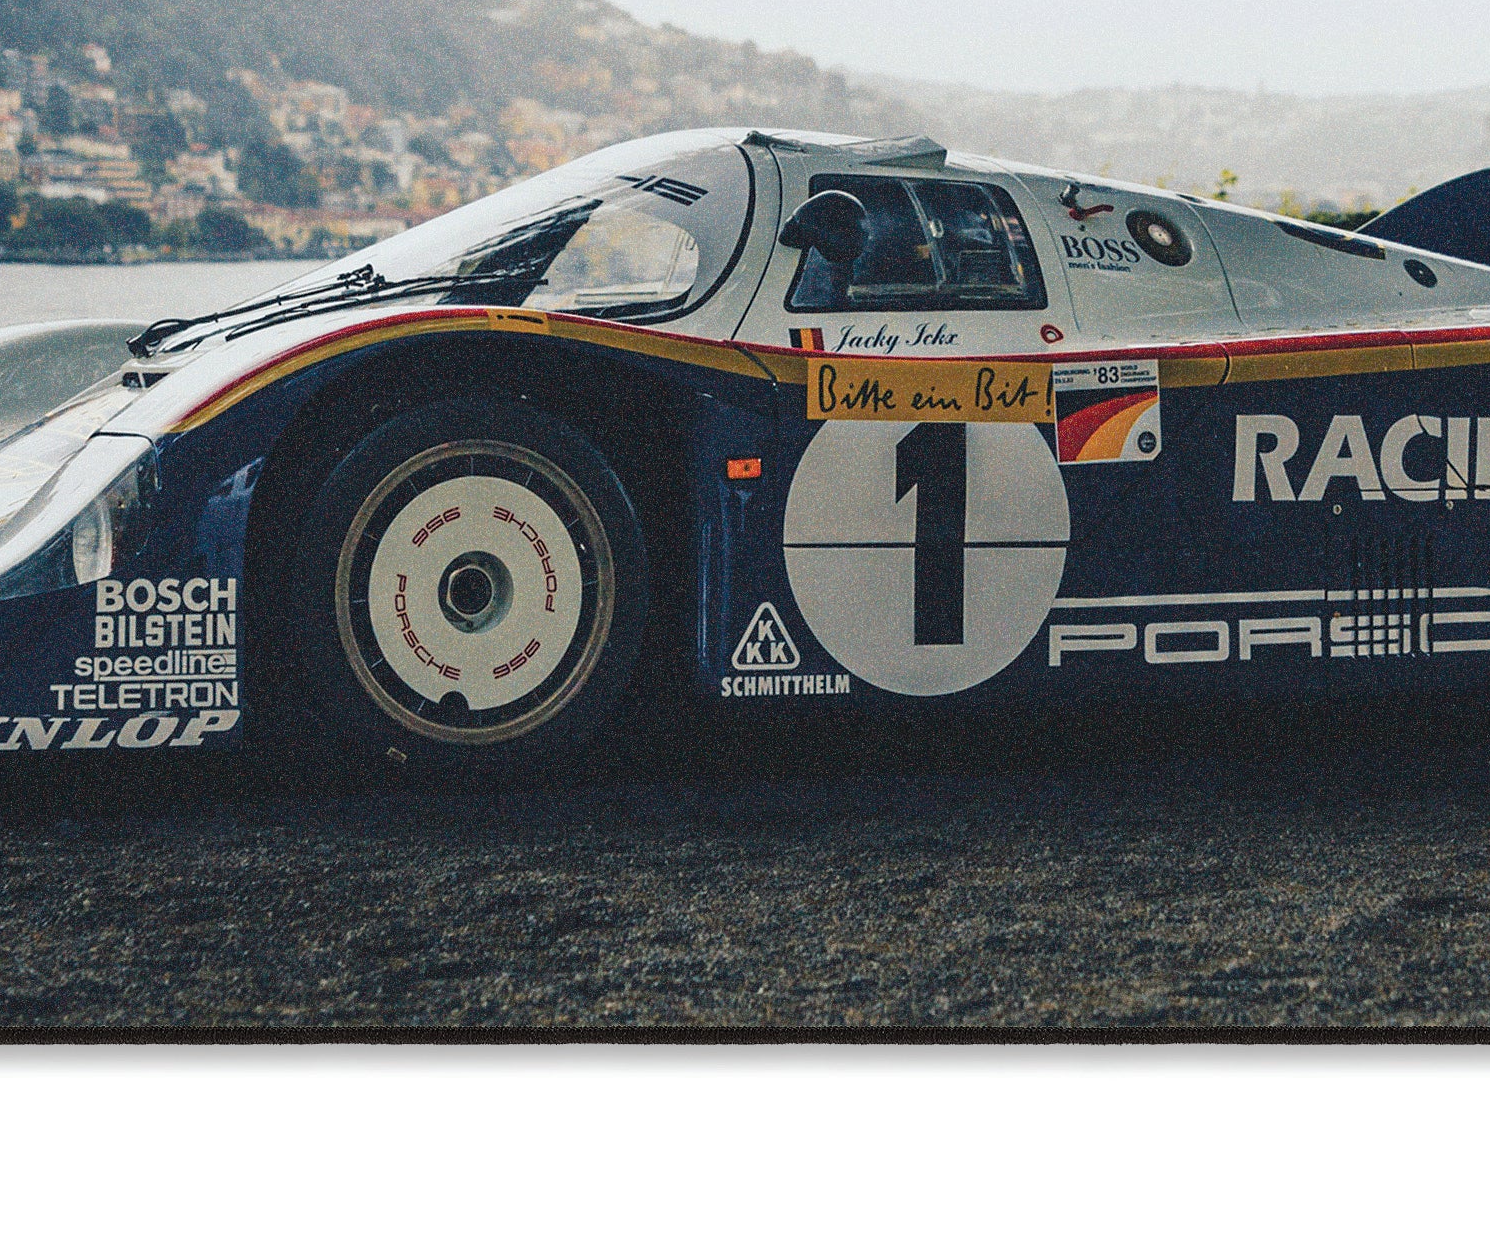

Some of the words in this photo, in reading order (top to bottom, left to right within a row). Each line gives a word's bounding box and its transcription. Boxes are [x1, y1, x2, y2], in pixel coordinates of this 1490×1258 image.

[1060, 235, 1141, 263] BOSS
[831, 324, 900, 354] Jacky
[905, 322, 959, 346] Ickx
[818, 364, 897, 413] Bitte
[911, 386, 962, 410] ein
[1093, 366, 1119, 384] '83
[412, 506, 461, 547] 956
[895, 422, 968, 646] 1
[493, 506, 558, 612] PORSCHE
[96, 577, 237, 614] BOSCH
[95, 612, 237, 649] BILSTEIN
[394, 573, 461, 681] PORSCHE
[74, 649, 229, 682] speedline
[493, 637, 541, 680] 956
[49, 681, 239, 710] TELETRON
[721, 674, 850, 696] SCHMITTHELM
